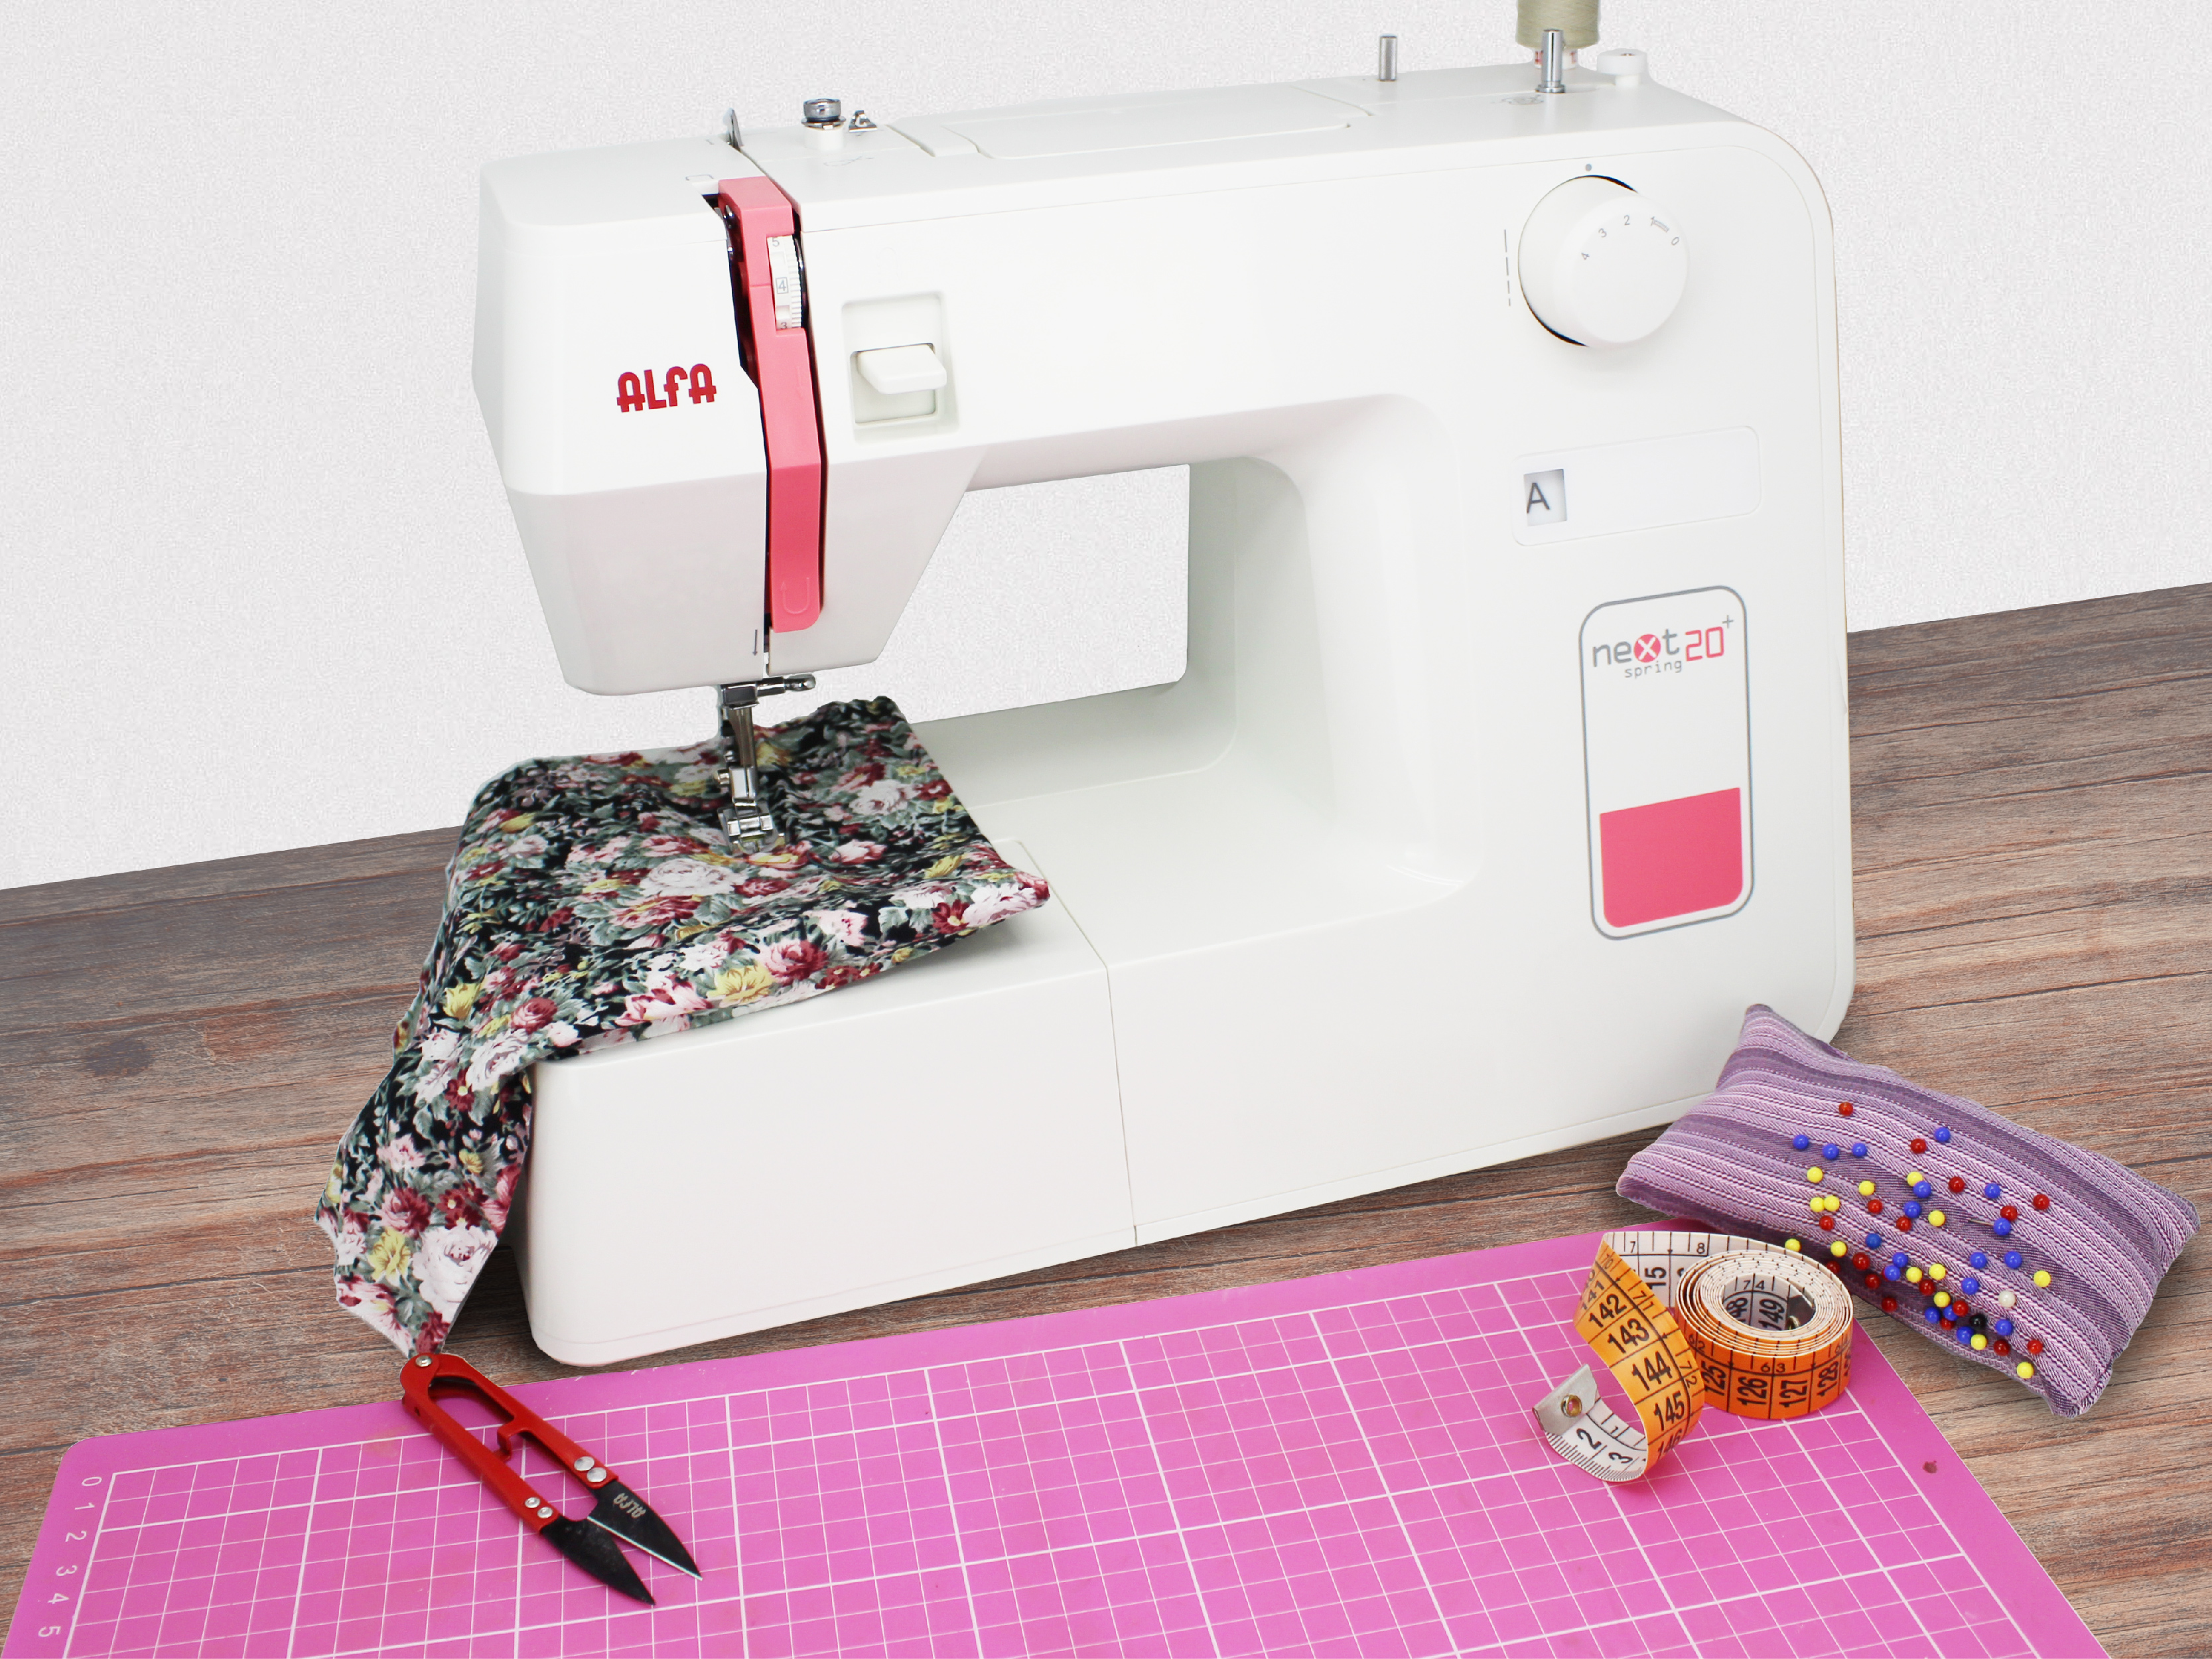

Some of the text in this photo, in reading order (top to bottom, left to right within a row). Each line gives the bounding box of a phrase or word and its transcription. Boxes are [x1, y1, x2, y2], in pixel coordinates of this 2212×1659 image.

[772, 237, 780, 247] 5
[1598, 228, 1607, 238] 3
[1624, 215, 1630, 226] 2
[1671, 237, 1679, 246] 0
[778, 279, 787, 291] 4
[1526, 482, 1550, 514] A
[1592, 628, 1680, 667] next
[1625, 660, 1682, 679] spring
[1629, 1241, 1636, 1253] 7
[1696, 1243, 1705, 1254] 8
[1588, 1294, 1627, 1328] 142
[1758, 1299, 1785, 1331] 149
[1607, 1318, 1650, 1354] 143
[1631, 1350, 1673, 1391] 144
[1701, 1360, 1726, 1396] 125
[1817, 1361, 1838, 1396] 128
[1736, 1376, 1767, 1406] 126
[1779, 1380, 1807, 1407] 127
[1653, 1390, 1685, 1431] 145
[1576, 1428, 1602, 1450] 2
[1608, 1453, 1633, 1464] 3
[82, 1476, 102, 1486] 0
[65, 1530, 87, 1542] 2
[56, 1565, 78, 1577] 3
[48, 1593, 70, 1605] 4
[38, 1626, 61, 1638] 5
